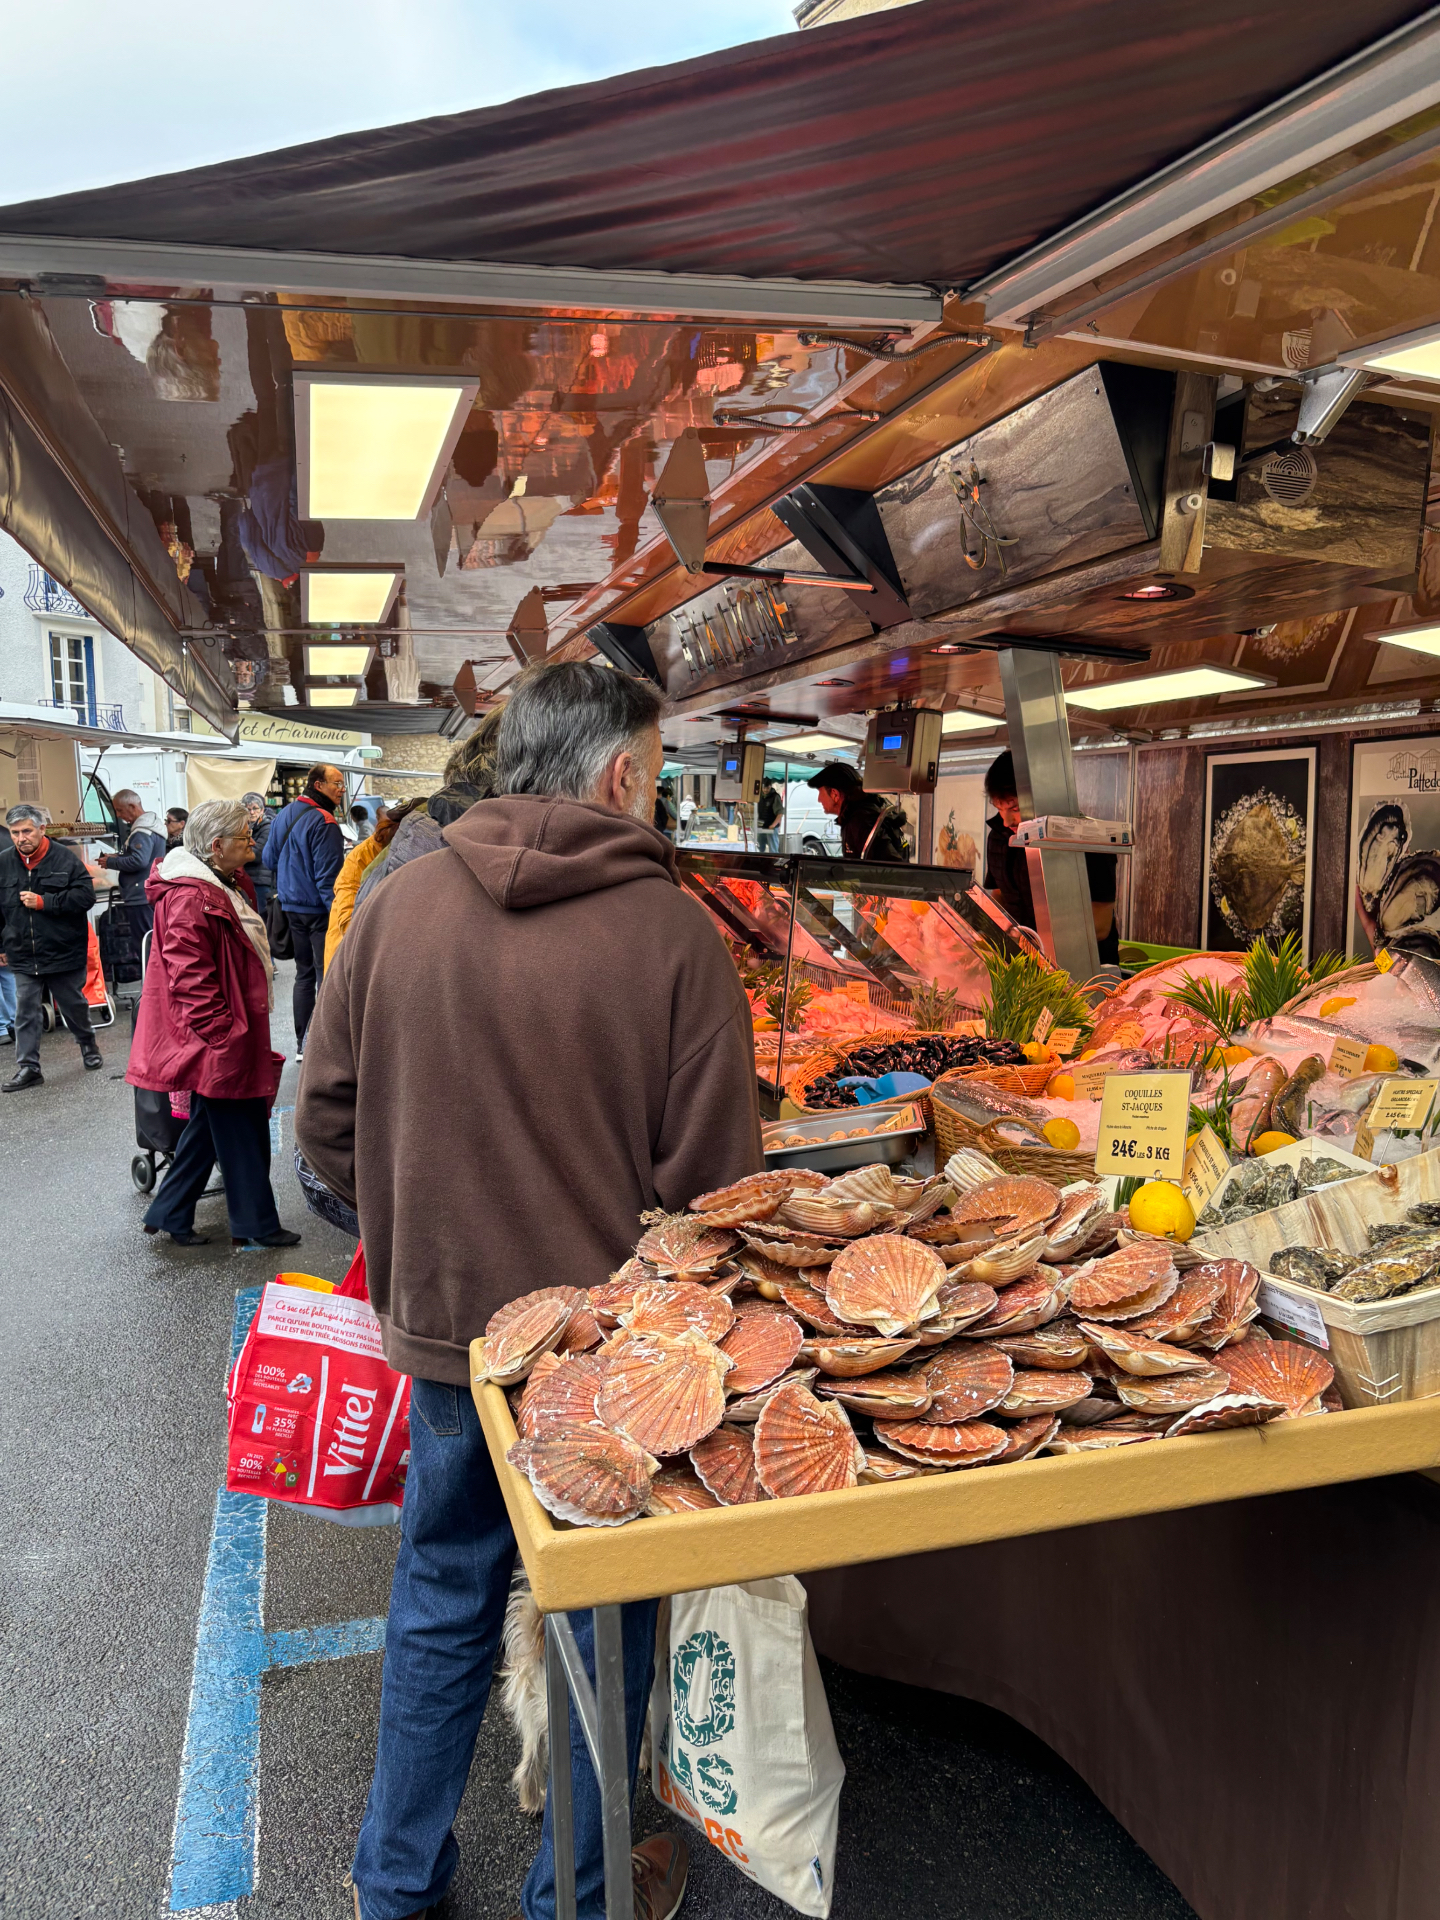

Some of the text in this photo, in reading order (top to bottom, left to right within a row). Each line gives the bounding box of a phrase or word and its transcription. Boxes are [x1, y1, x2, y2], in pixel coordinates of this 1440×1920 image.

[262, 719, 350, 742] d'Harmonie
[1124, 1089, 1163, 1100] COQUILLES
[1121, 1102, 1163, 1113] ST-JACQUES
[1111, 1139, 1137, 1158] 24€
[1146, 1146, 1152, 1159] 3
[1155, 1147, 1170, 1160] KG
[275, 1300, 285, 1310] Ce
[267, 1315, 286, 1324] PARCE
[287, 1318, 310, 1327] QU'UNE
[311, 1322, 339, 1334] BOUTEILLE
[340, 1329, 356, 1339] N'EST
[275, 1324, 288, 1332] ELLE
[300, 1328, 314, 1336] BIEN
[315, 1330, 331, 1340] TRIÉE,
[331, 1336, 358, 1348] AGISSONS
[359, 1342, 384, 1354] ENSEMBL
[256, 1364, 286, 1378] 100%
[273, 1417, 296, 1430] 35%
[323, 1383, 378, 1477] Vittel
[240, 1458, 263, 1470] 90%
